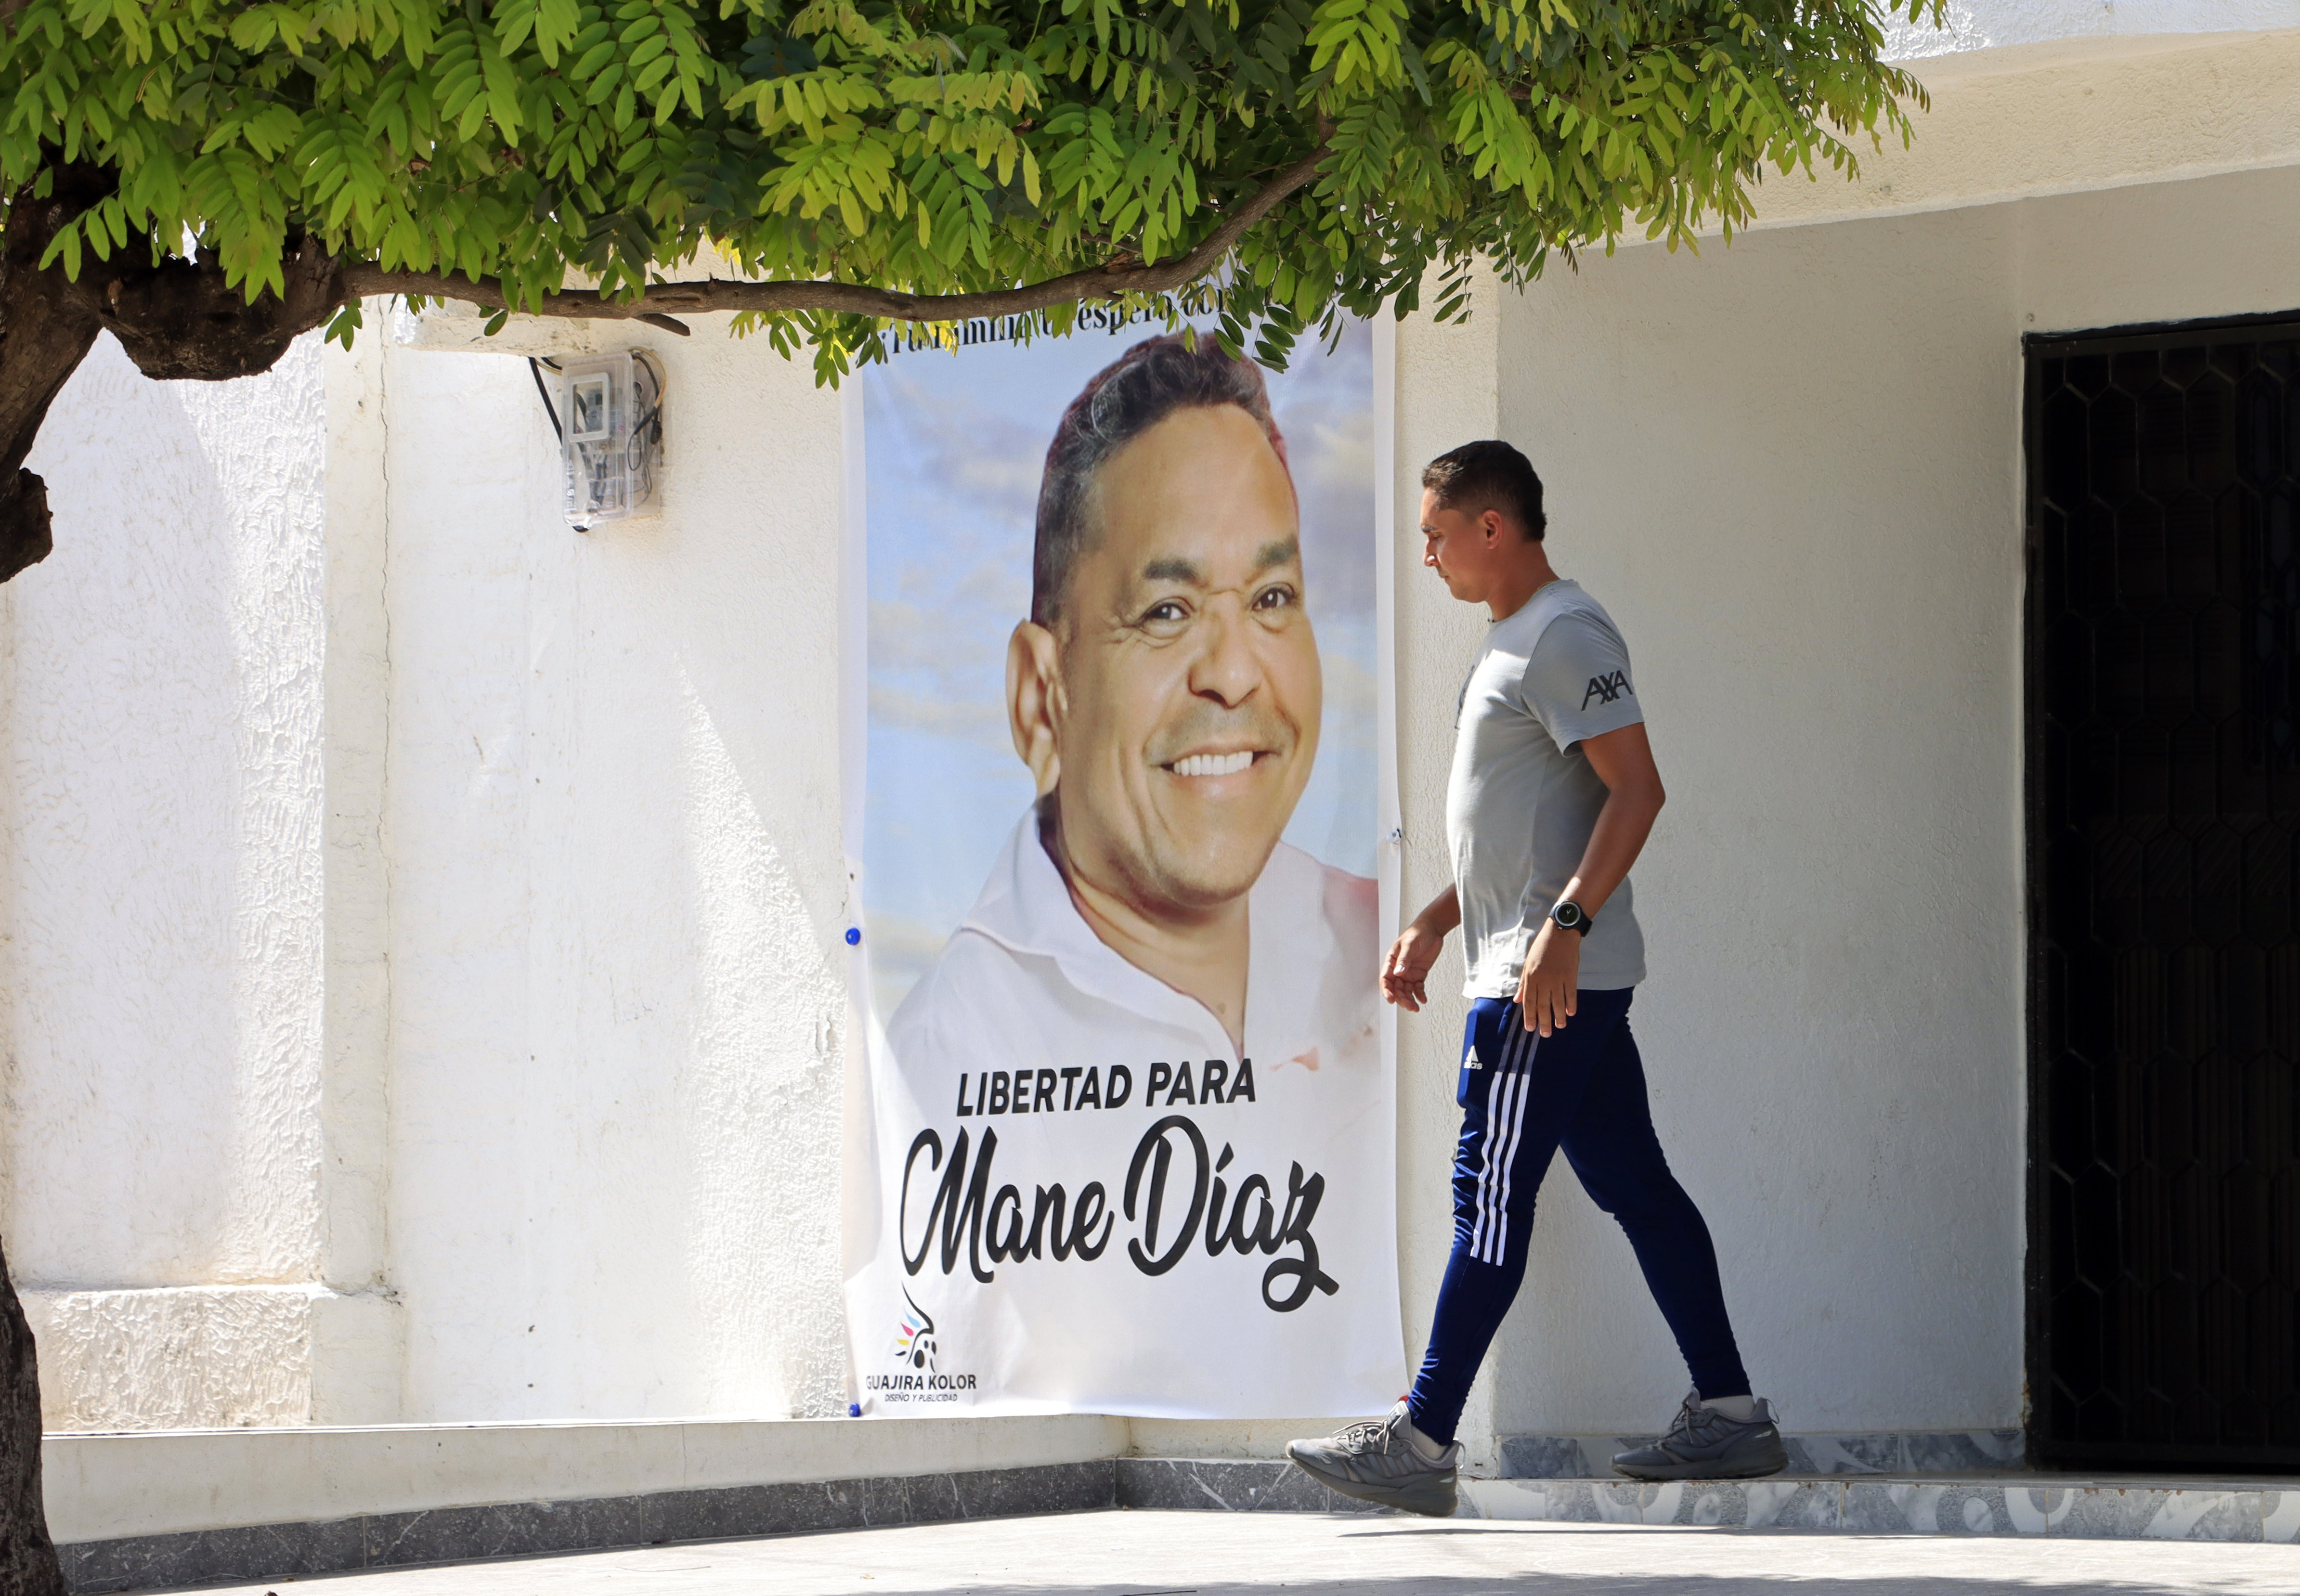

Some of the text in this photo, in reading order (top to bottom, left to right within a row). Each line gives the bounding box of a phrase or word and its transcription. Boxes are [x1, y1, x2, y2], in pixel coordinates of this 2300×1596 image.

[1581, 670, 1633, 712] AXA
[957, 1058, 1256, 1116] LIBERTAD PARA
[900, 1115, 1339, 1312] Mane Díaz
[866, 1374, 977, 1390] GUAJIRA KOLOR
[884, 1392, 910, 1402] DISEÑO
[918, 1393, 958, 1402] PUBLICIDAD
